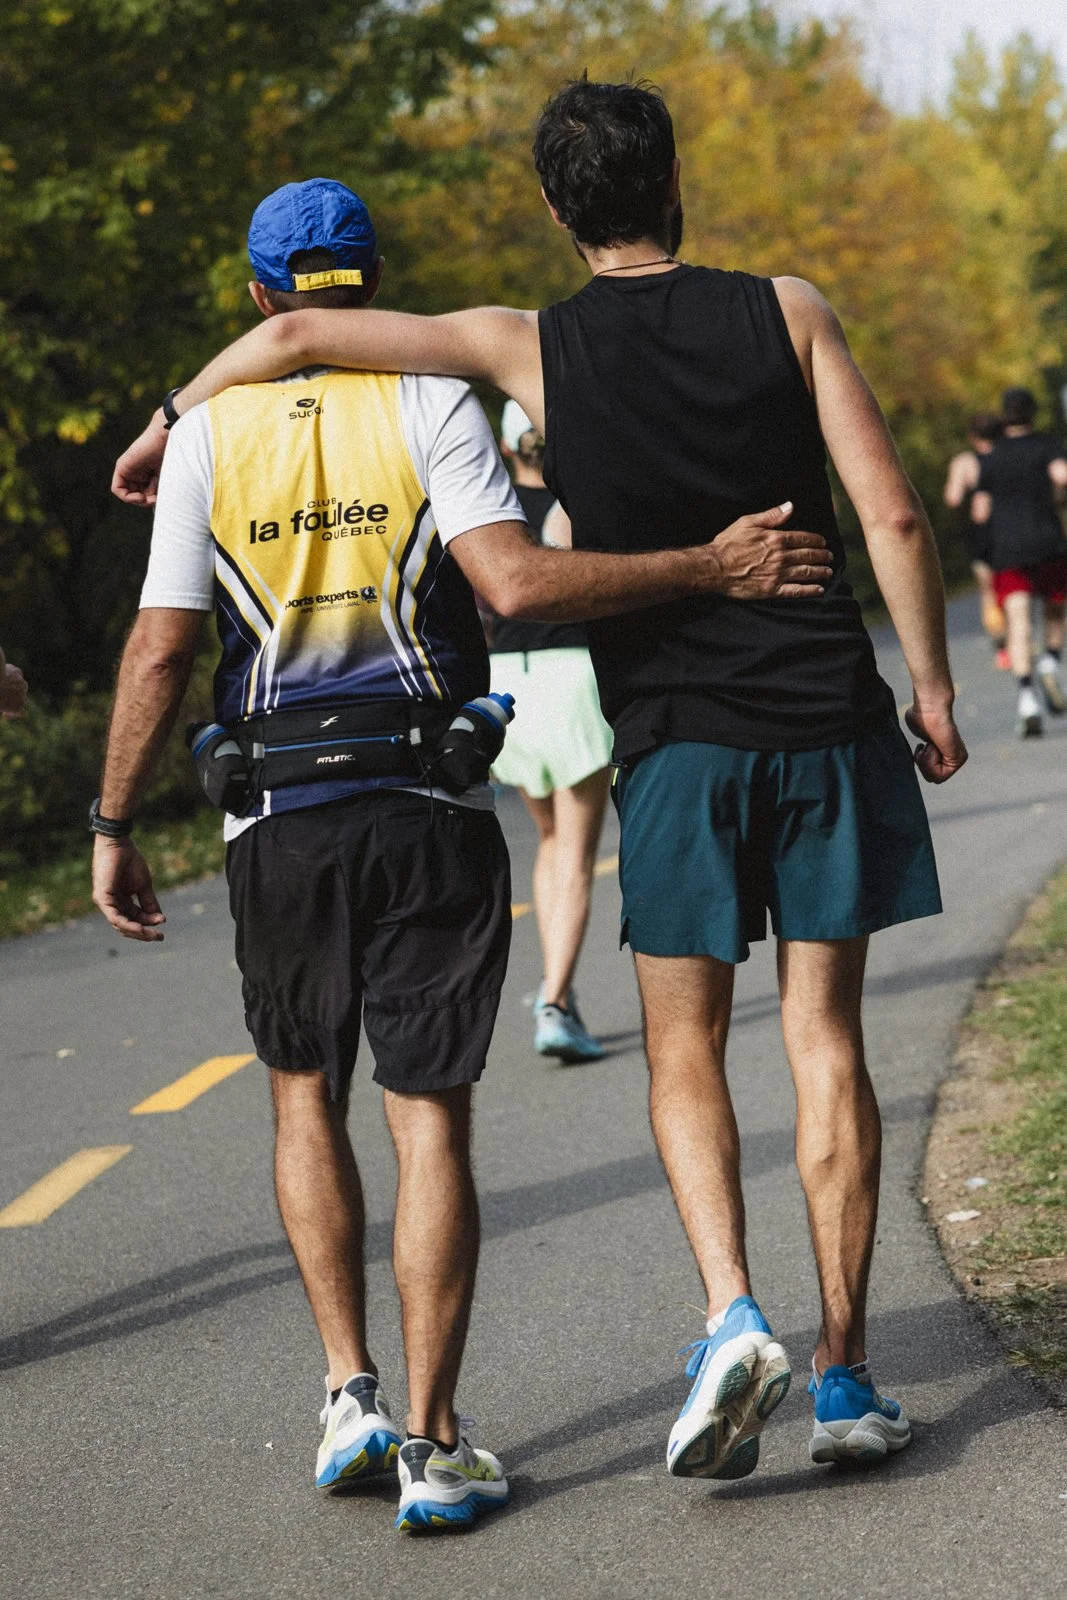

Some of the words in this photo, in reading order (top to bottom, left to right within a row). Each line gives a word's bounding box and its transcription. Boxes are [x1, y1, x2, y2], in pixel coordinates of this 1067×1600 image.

[307, 498, 336, 508] CLUB
[250, 520, 279, 544] la
[290, 499, 389, 535] foulée
[322, 525, 387, 541] QUÉBEC
[284, 596, 314, 610] ports
[316, 589, 358, 604] experts
